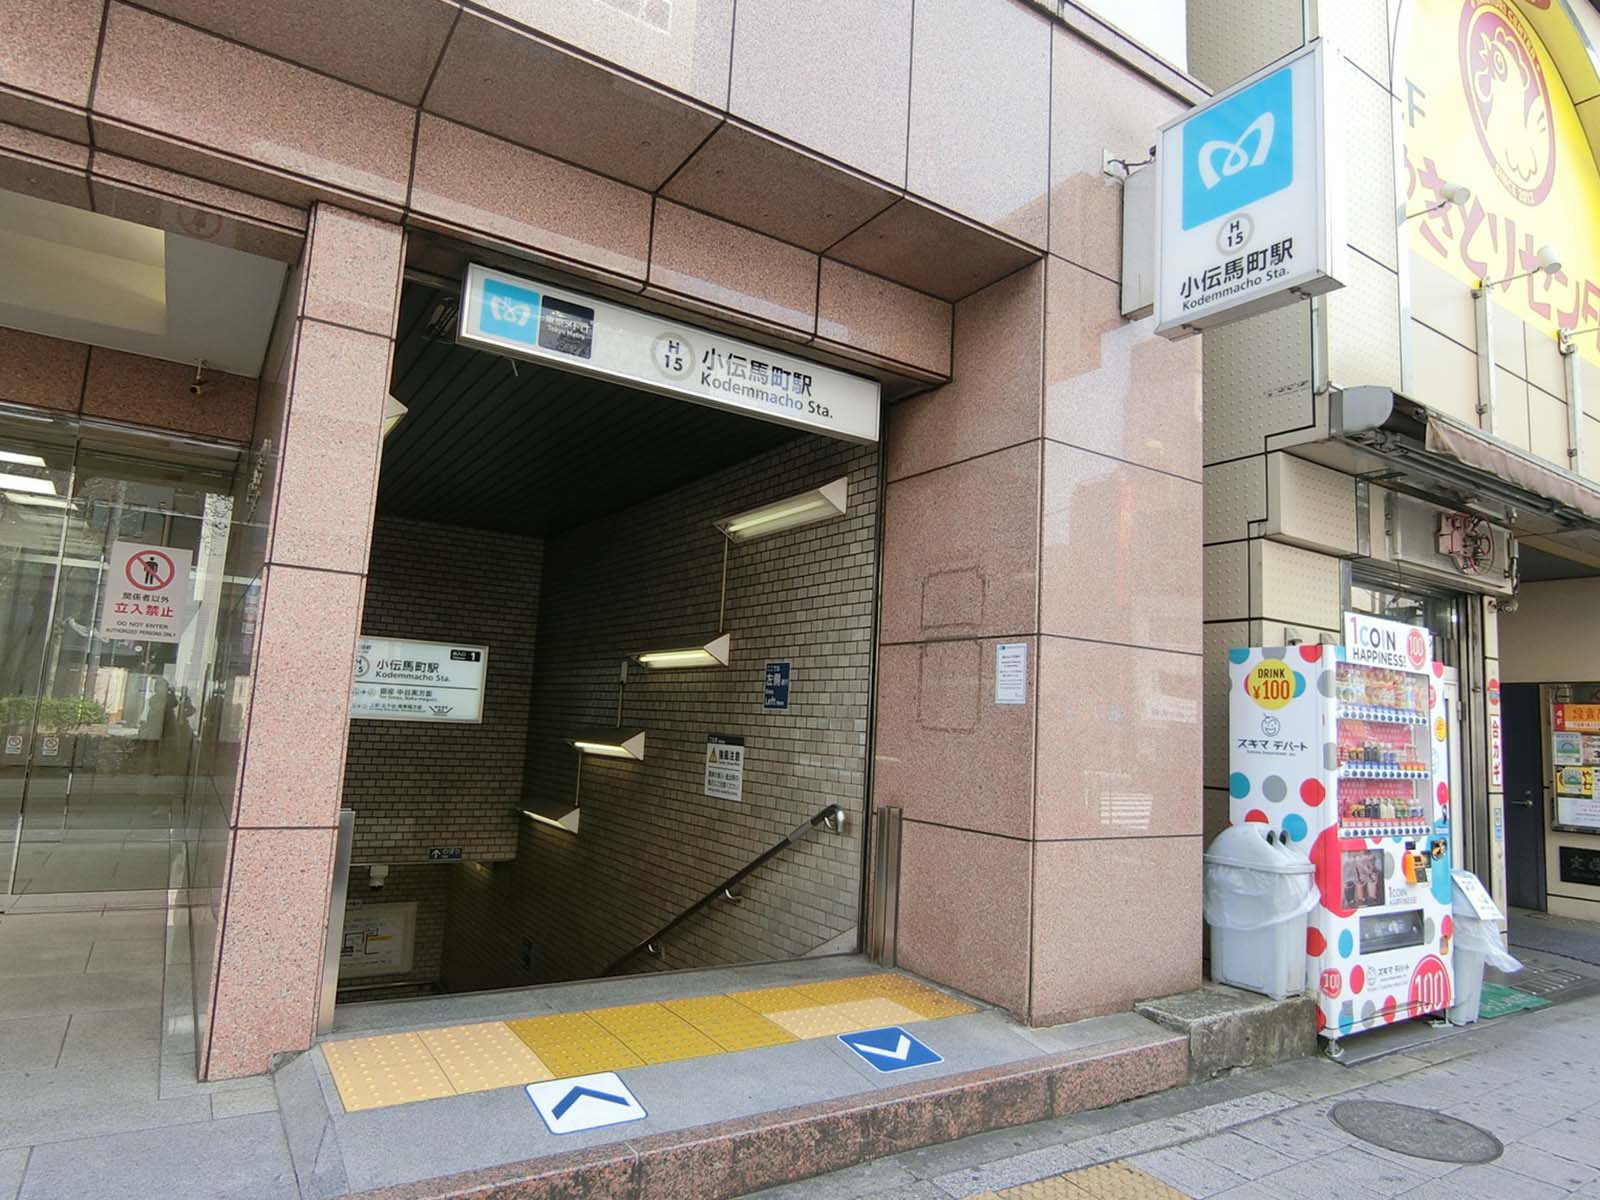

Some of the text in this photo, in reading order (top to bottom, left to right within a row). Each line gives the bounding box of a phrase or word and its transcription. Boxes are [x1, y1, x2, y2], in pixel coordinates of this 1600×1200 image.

[1230, 220, 1240, 233] H
[1227, 231, 1244, 248] 15
[1180, 237, 1293, 299] 小伝馬町駅
[1182, 267, 1290, 312] Kodemmacho Sta.
[668, 340, 680, 355] H
[664, 354, 684, 372] 15
[702, 347, 812, 397] 小伝馬町駅
[701, 372, 834, 419] Kodemmacho Sta.
[114, 602, 174, 618] 立入禁止
[145, 622, 168, 630] ENTER
[471, 652, 476, 660] 1
[1353, 647, 1407, 668] HAPPINESS!
[376, 659, 440, 674] 小伝馬町駅
[1258, 668, 1285, 679] DRINK
[375, 671, 450, 682] Kodemmacho Sta.
[1252, 680, 1290, 700] ¥100
[1238, 738, 1308, 751] スキマ デパート
[1414, 970, 1445, 1015] 100
